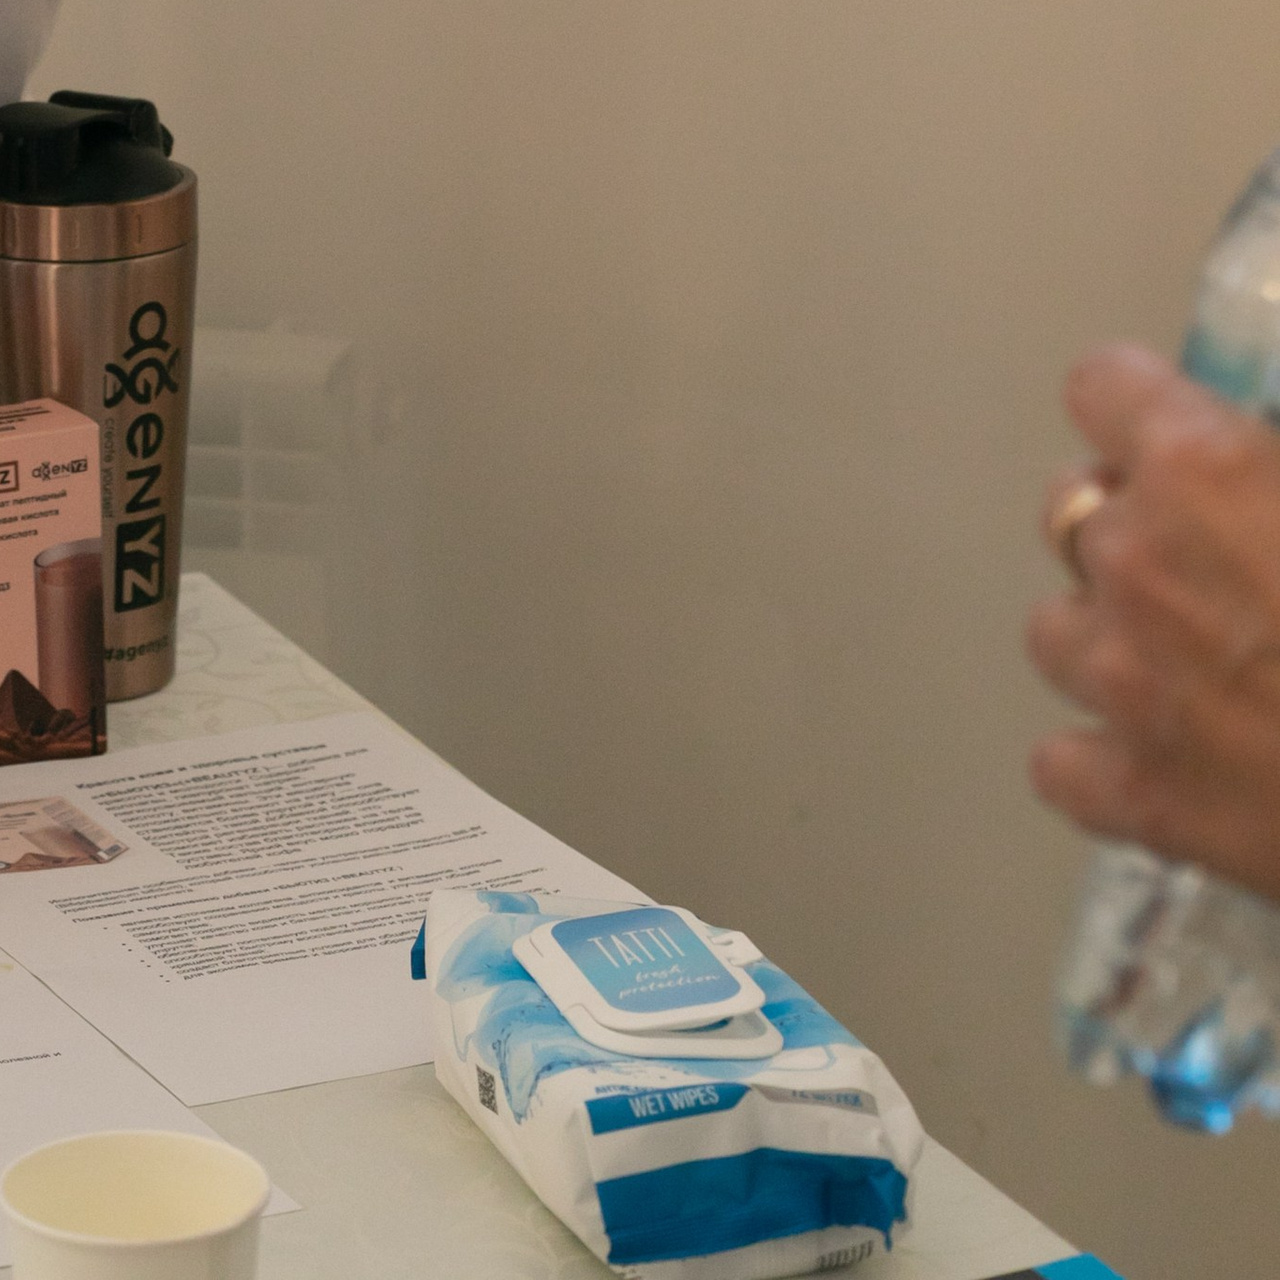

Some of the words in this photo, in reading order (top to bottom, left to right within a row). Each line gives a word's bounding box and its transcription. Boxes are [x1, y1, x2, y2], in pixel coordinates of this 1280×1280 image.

[104, 418, 117, 462] create
[587, 927, 685, 968] TATTI
[628, 1093, 666, 1118] WET
[667, 1085, 719, 1111] WIPES
